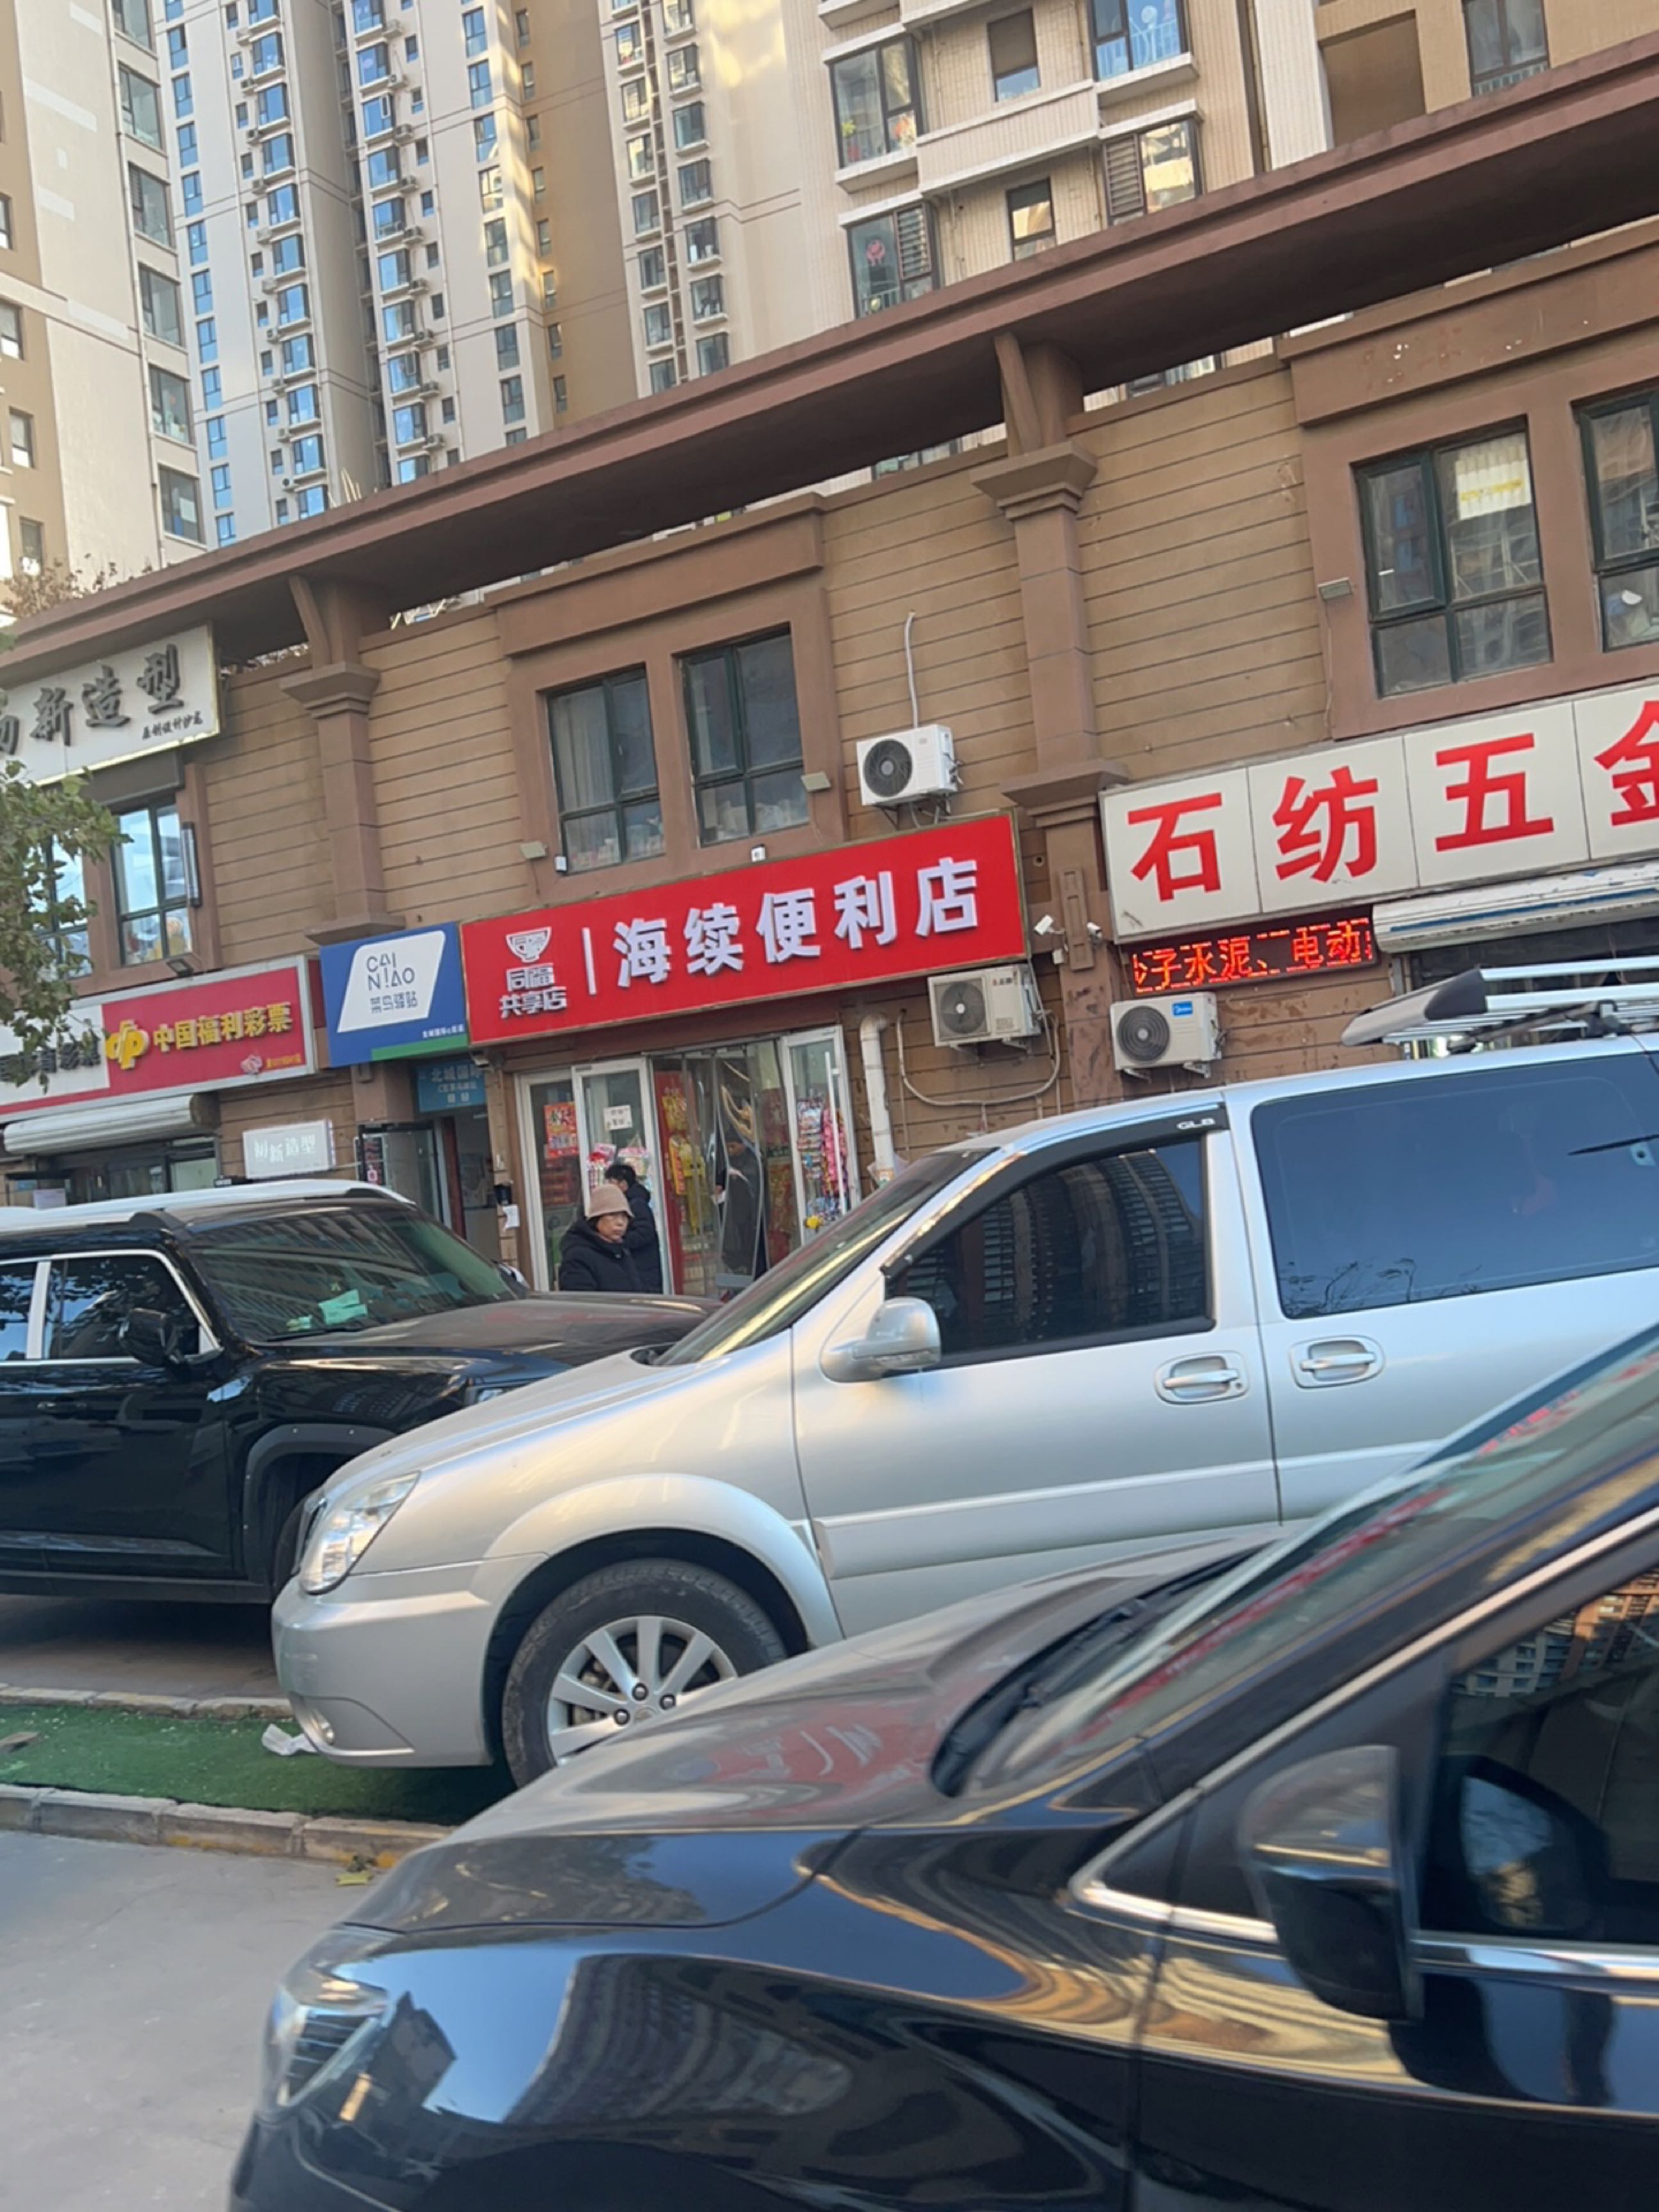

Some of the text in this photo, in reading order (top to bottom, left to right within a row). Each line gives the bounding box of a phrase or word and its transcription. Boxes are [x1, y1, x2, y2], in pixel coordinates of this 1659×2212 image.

[613, 856, 978, 988] 海续便利店
[366, 952, 397, 973] CAI
[506, 963, 556, 991] 同福
[369, 991, 419, 1014] 菜鸟驿站
[499, 986, 567, 1018] 共享店
[153, 1001, 293, 1052] 中国福利彩票
